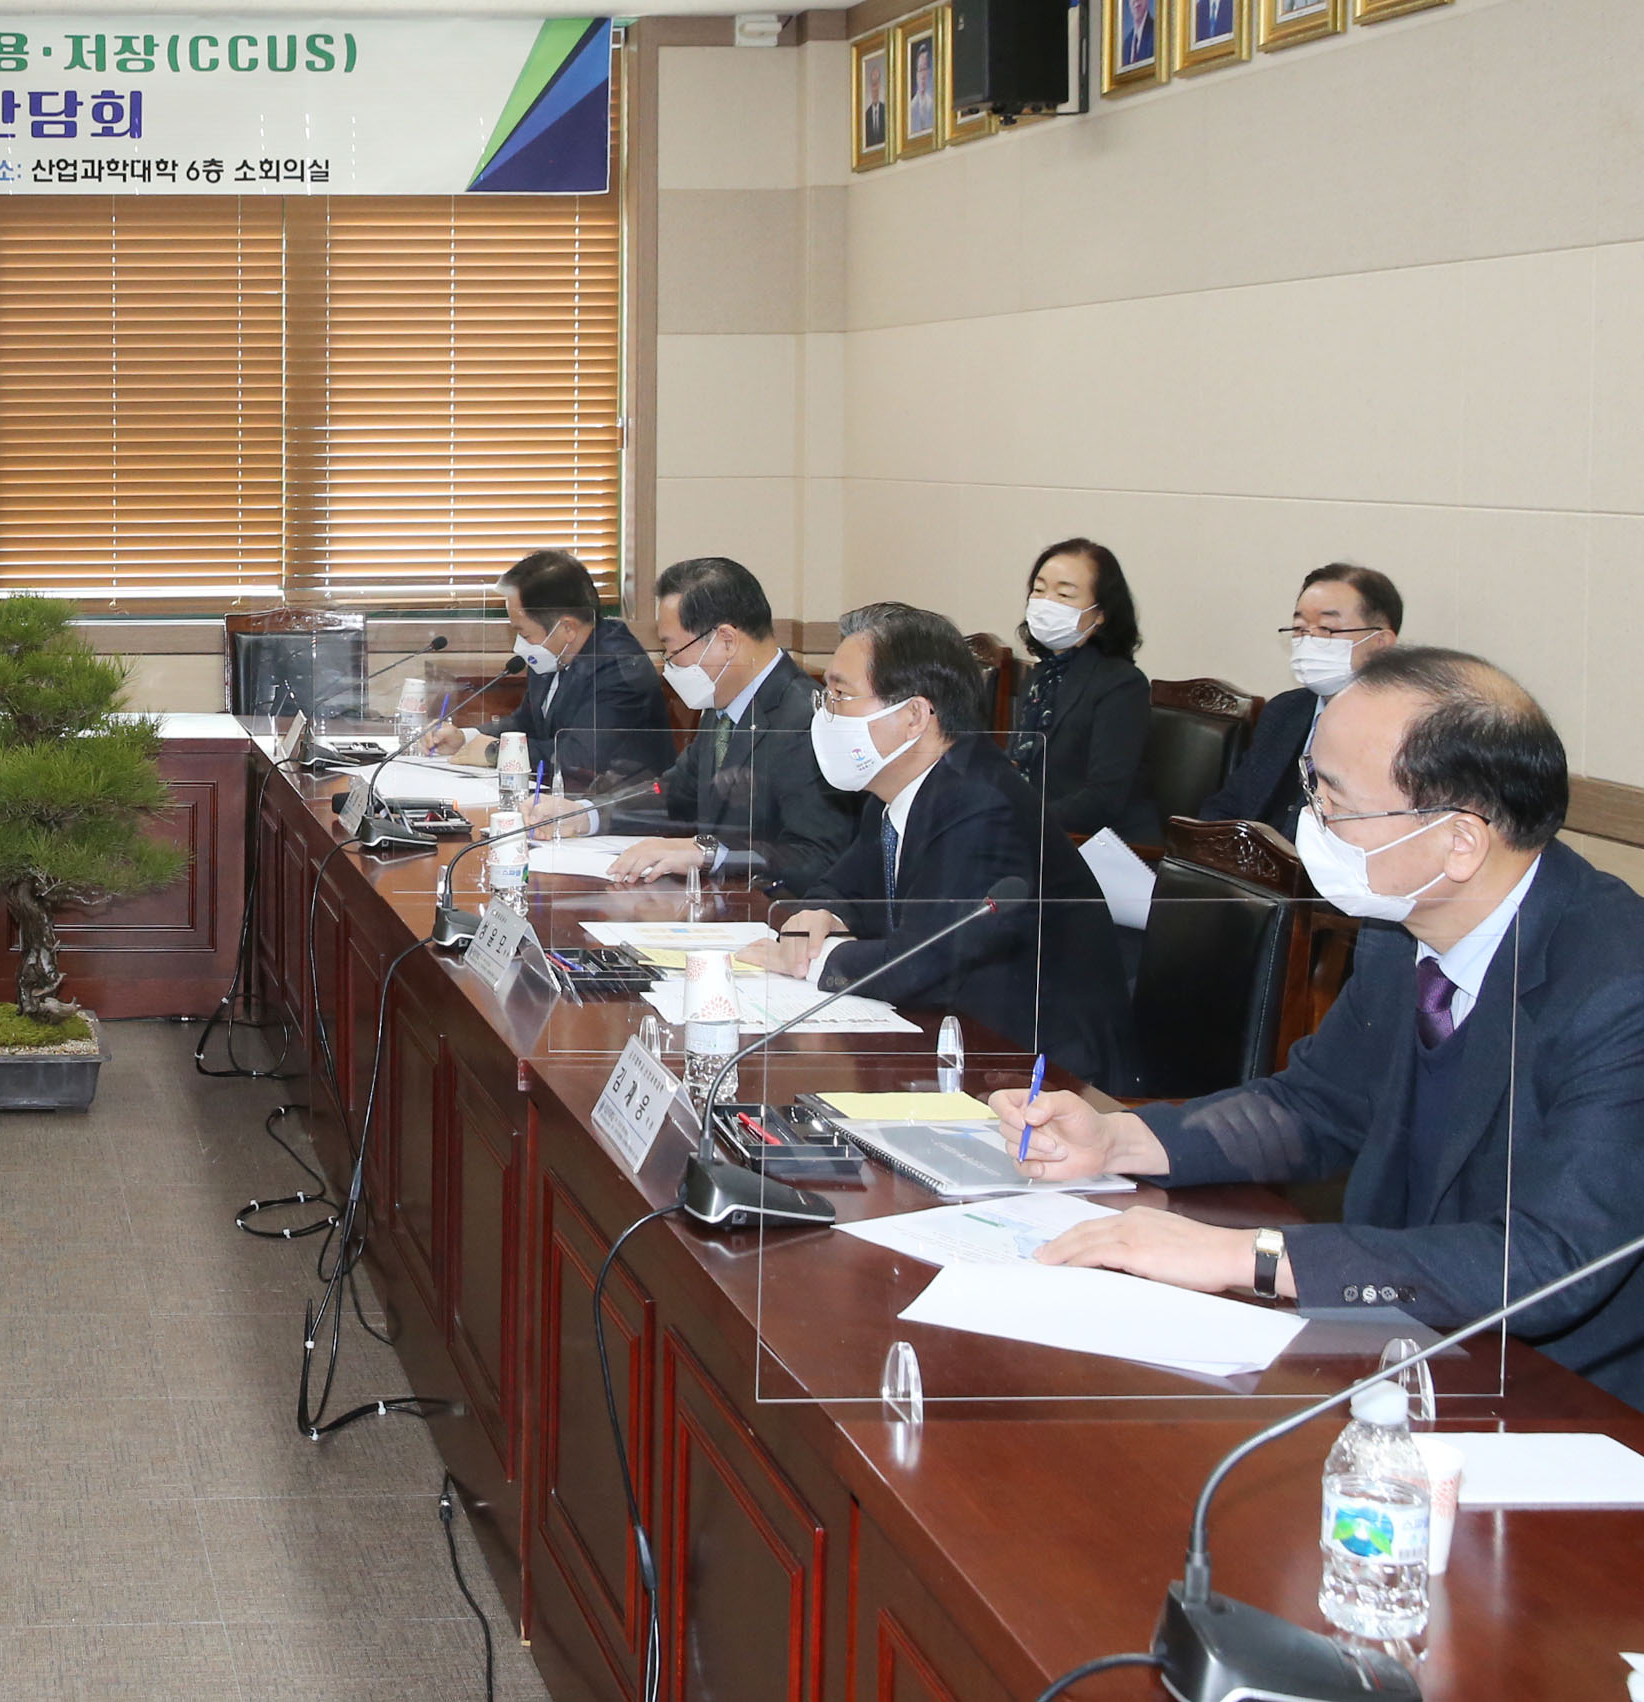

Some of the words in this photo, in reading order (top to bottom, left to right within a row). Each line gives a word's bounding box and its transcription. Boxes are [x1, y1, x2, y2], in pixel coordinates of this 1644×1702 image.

[30, 158, 179, 183] 산업과학대학
[186, 159, 224, 183] 6층
[233, 158, 331, 183] 소회의실
